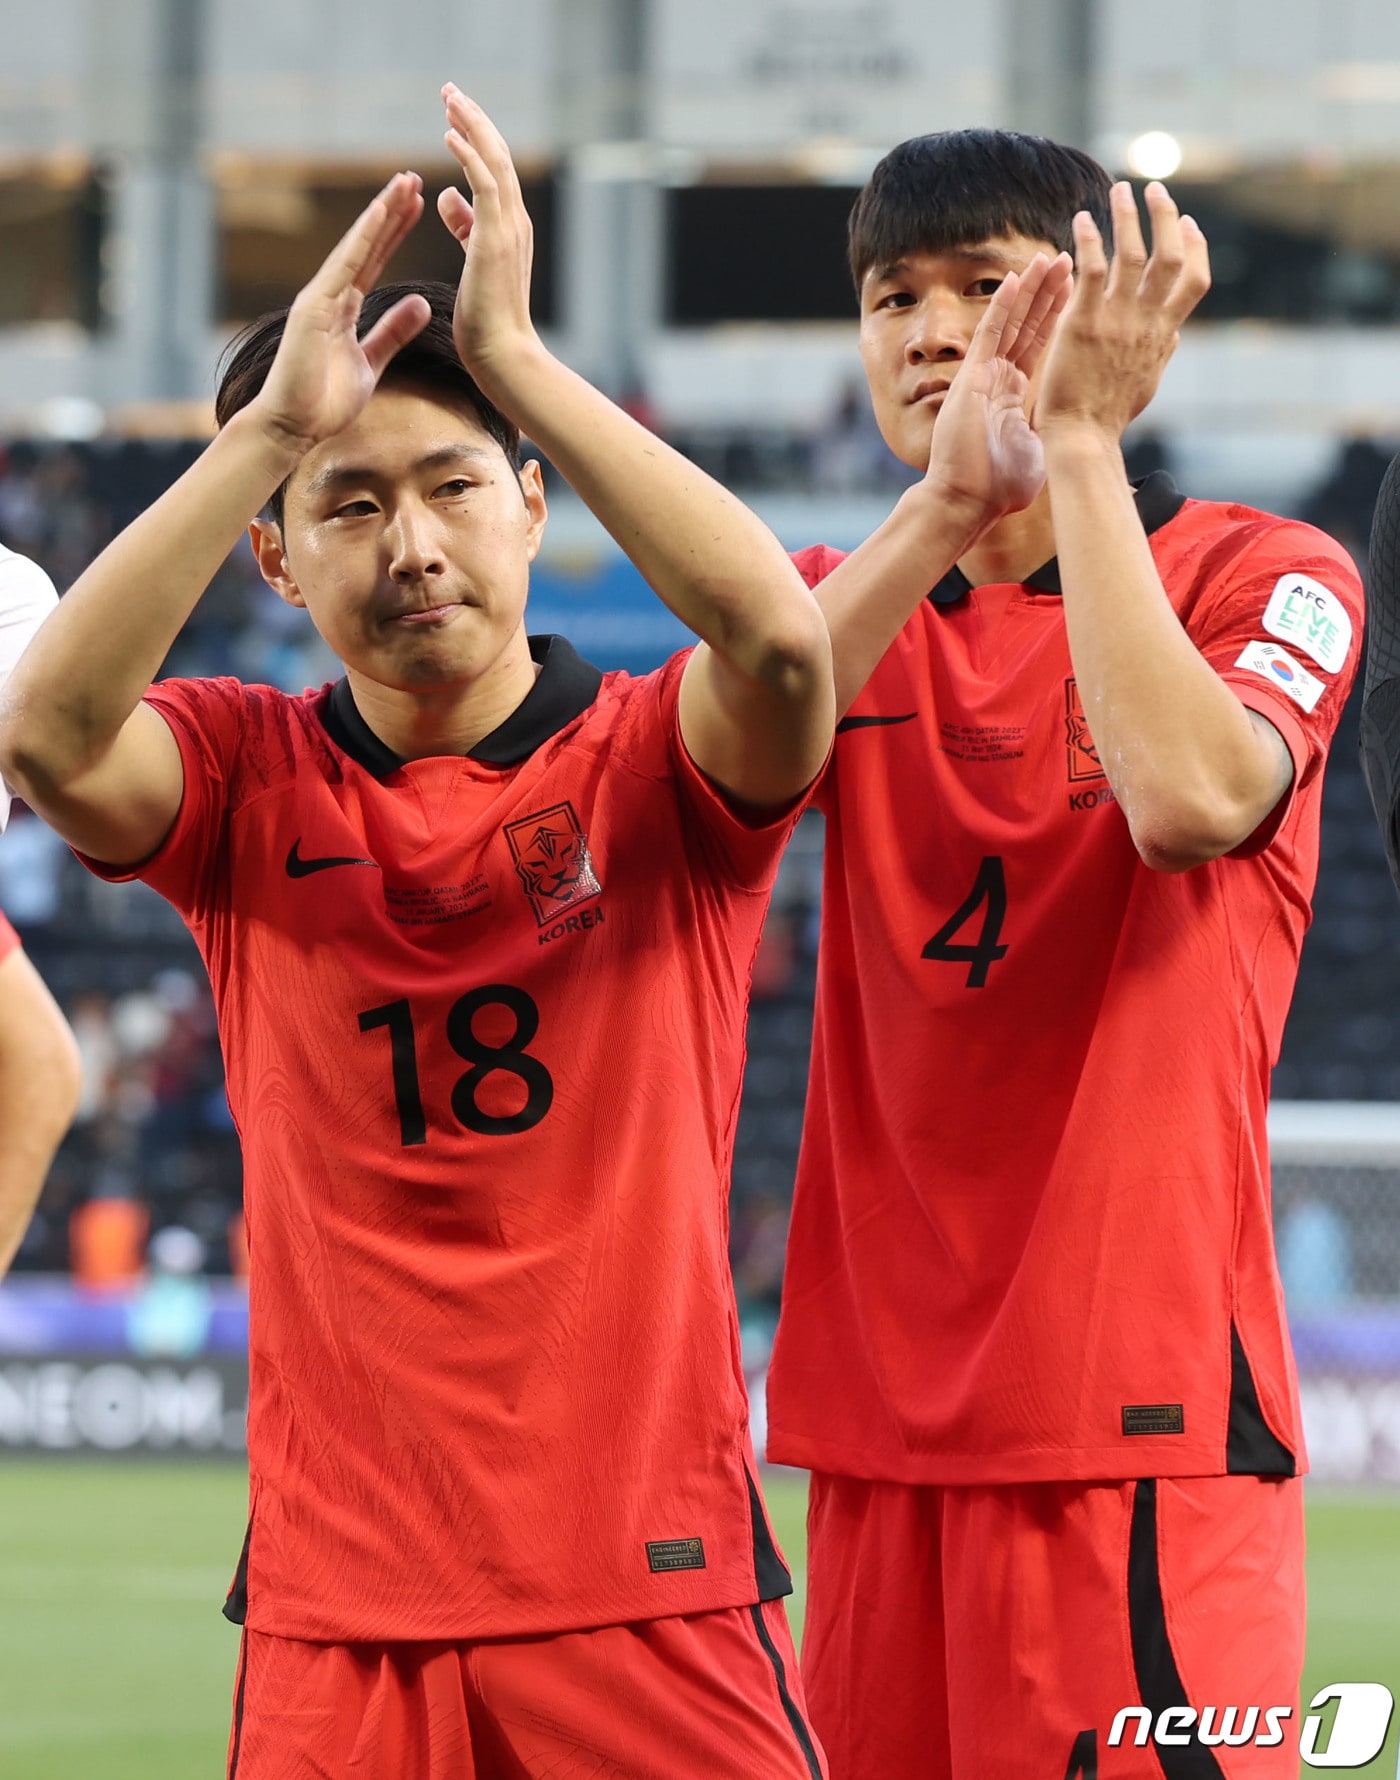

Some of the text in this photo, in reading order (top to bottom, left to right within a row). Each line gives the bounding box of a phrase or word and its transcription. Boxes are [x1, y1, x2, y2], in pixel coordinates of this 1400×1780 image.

[1291, 586, 1327, 610] AFC
[538, 906, 605, 945] KOREA
[921, 856, 1009, 988] 4
[358, 984, 554, 1146] 18
